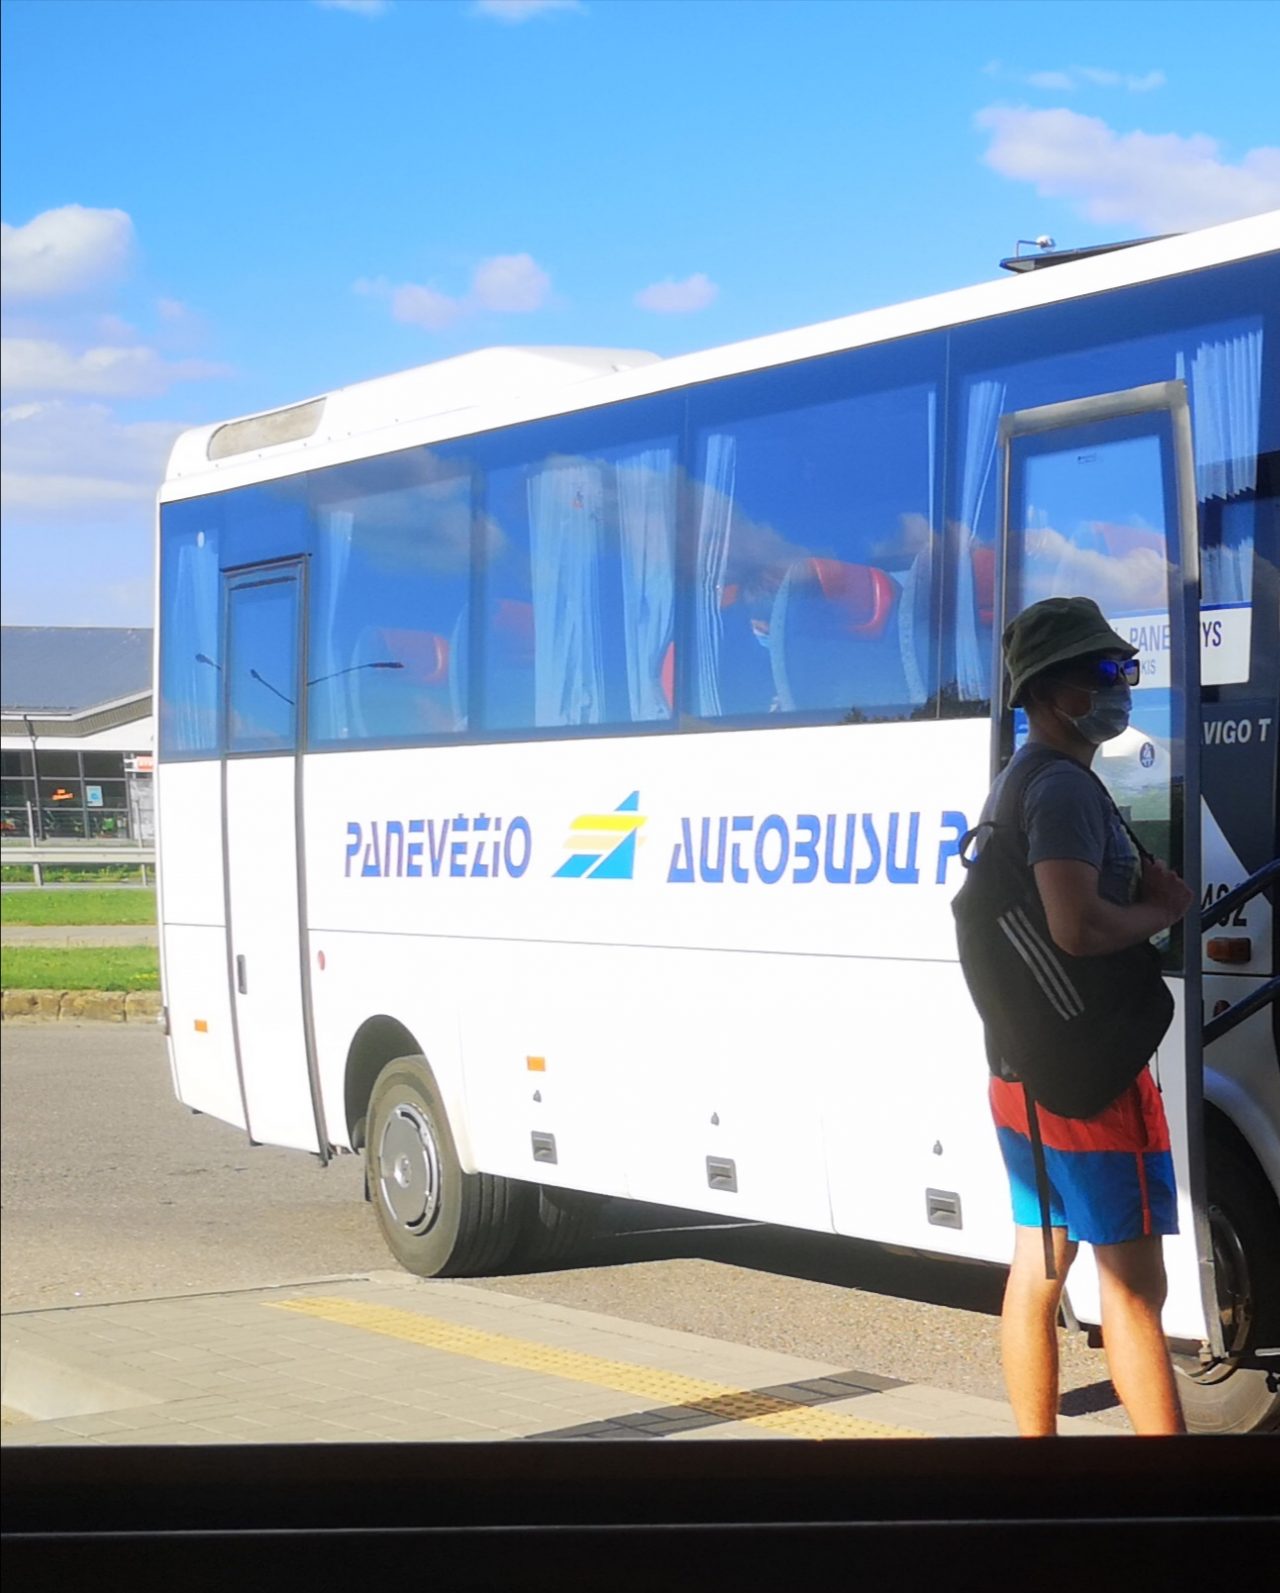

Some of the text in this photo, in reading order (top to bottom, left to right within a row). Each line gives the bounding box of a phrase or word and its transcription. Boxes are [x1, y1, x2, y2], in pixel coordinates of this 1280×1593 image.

[1201, 717, 1272, 745] VIGO T
[344, 812, 532, 879] PANEVĖŽIO
